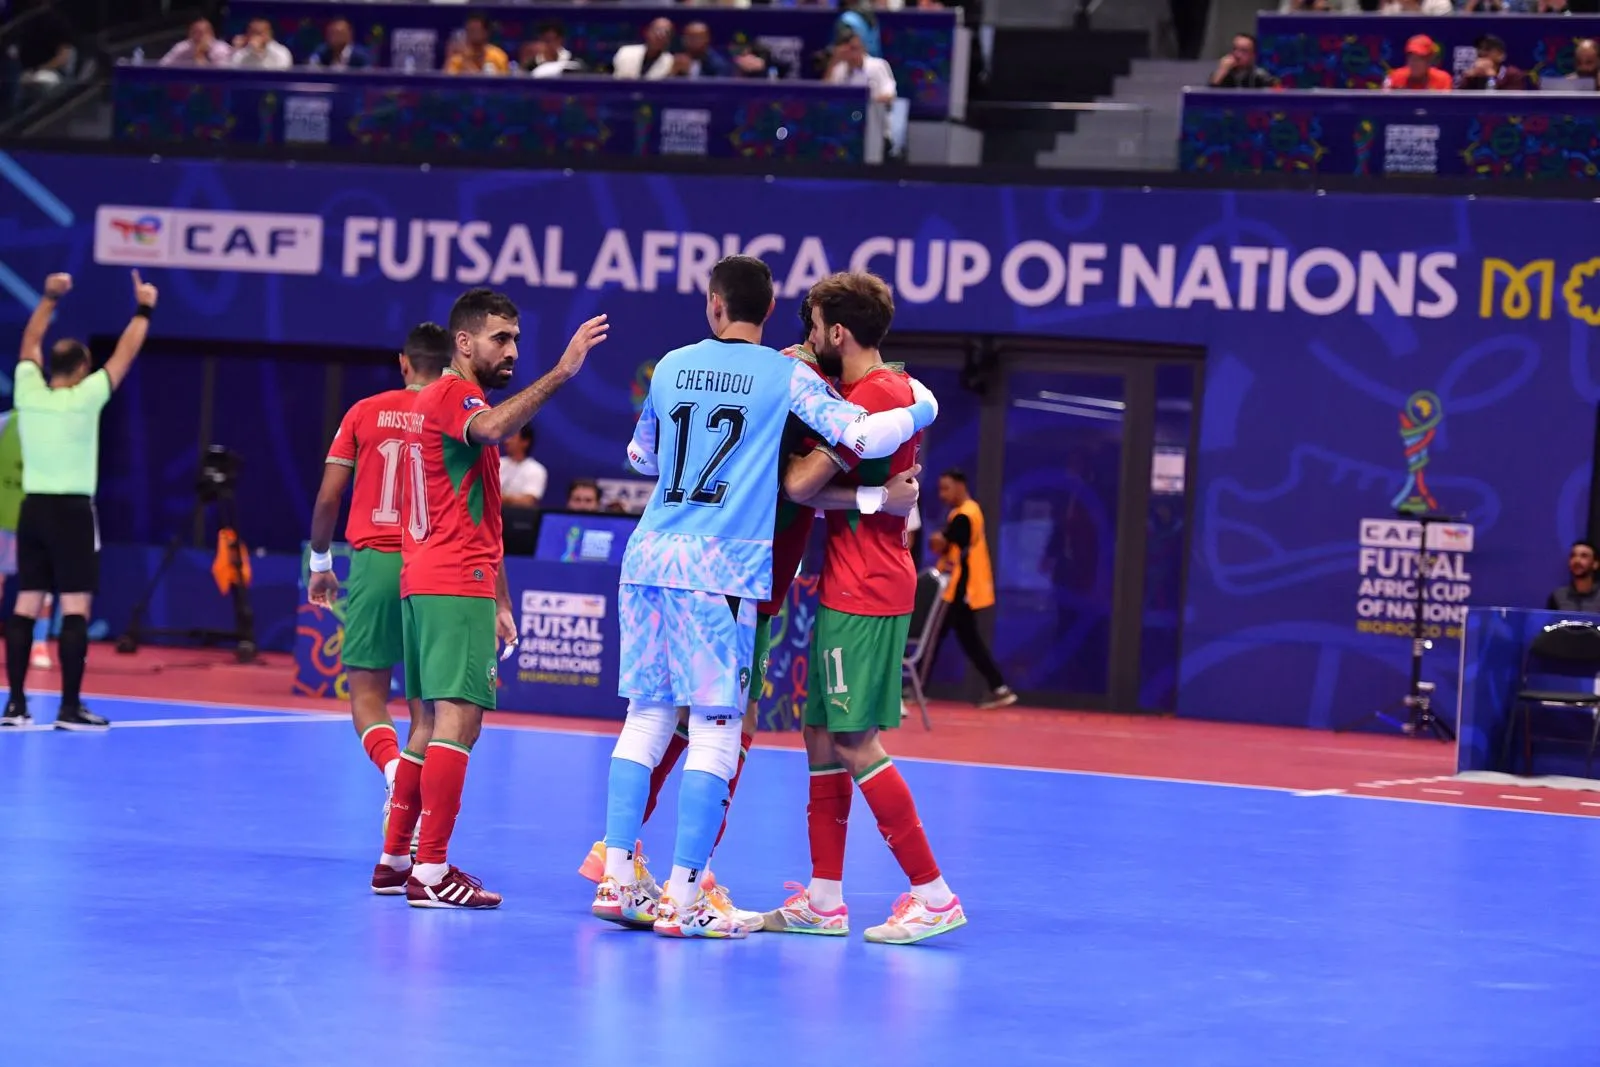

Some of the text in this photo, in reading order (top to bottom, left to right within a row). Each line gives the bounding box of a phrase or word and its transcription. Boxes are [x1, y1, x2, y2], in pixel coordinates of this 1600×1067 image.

[184, 223, 297, 257] CAF
[342, 217, 577, 288] FUTSAL
[849, 236, 991, 303] CUP
[1001, 240, 1107, 307] OF
[1118, 244, 1459, 319] NATIONS
[675, 369, 754, 395] CHERIDOU
[663, 402, 748, 508] 12
[1366, 525, 1420, 541] CAF
[1359, 578, 1471, 601] AFRIC CUP
[1357, 598, 1468, 622] OF NAIONS
[521, 614, 604, 641] FUTSAL
[518, 653, 538, 670] OF
[823, 647, 848, 694] 11
